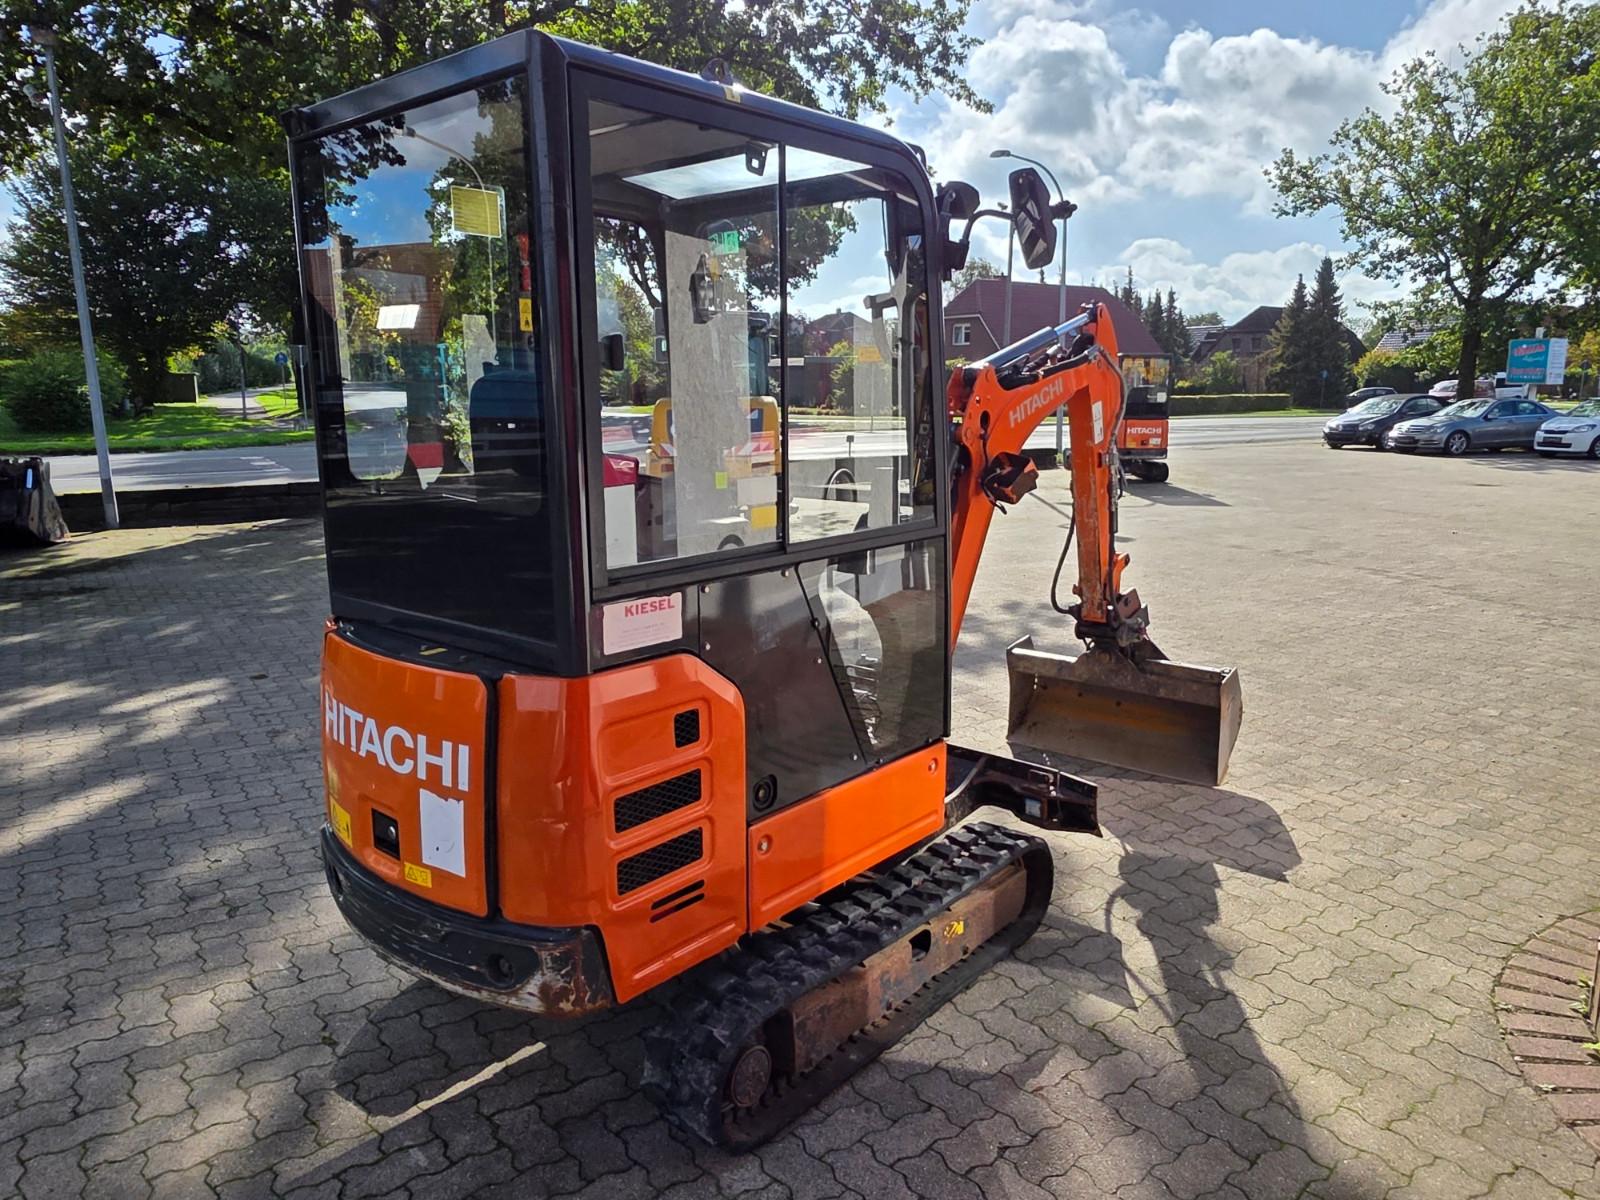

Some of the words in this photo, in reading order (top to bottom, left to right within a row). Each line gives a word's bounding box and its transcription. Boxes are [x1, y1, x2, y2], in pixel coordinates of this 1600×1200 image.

[1009, 378, 1064, 428] HITACHI
[1127, 427, 1162, 435] HITACHI
[624, 598, 676, 618] KIESEL
[324, 691, 470, 792] HITACHI
